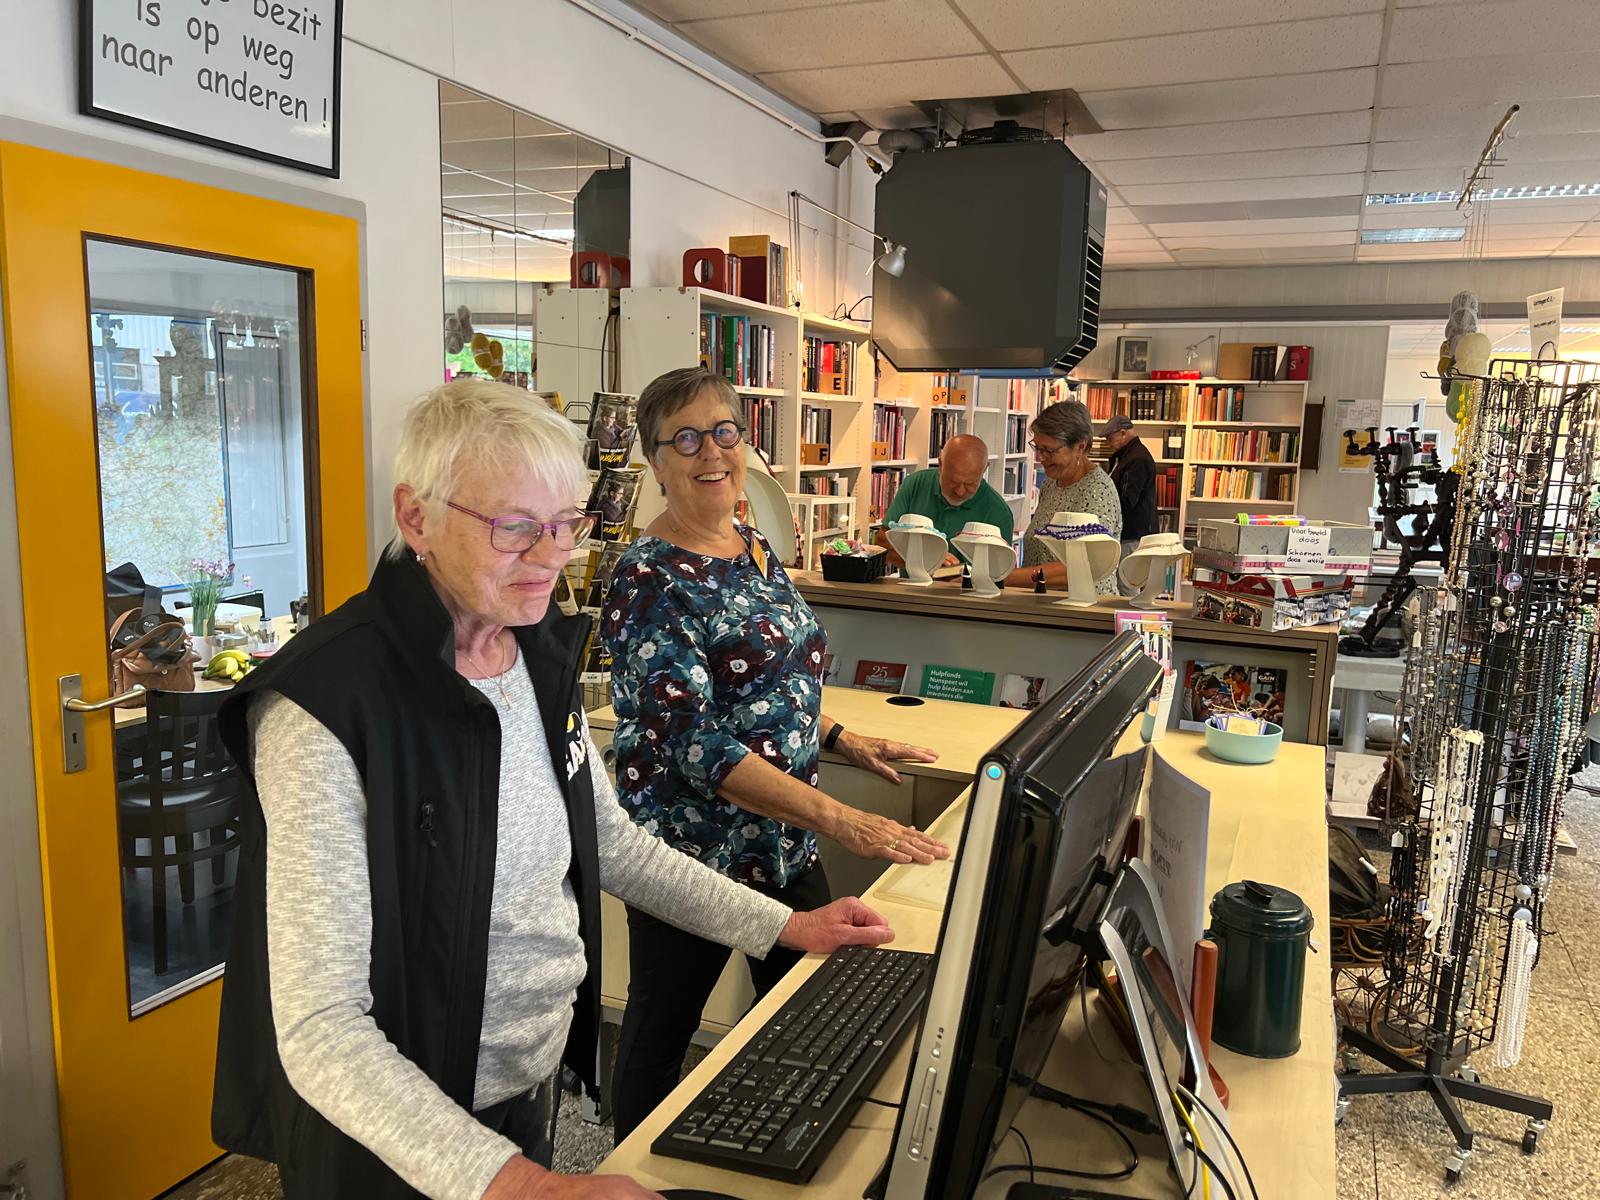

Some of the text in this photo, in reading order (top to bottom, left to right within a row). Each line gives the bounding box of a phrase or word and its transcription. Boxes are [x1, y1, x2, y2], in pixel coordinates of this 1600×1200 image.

[186, 17, 220, 54] op
[242, 34, 294, 80] weg
[102, 33, 174, 77] naar
[197, 70, 308, 123] anderen
[833, 377, 842, 390] E
[819, 447, 828, 462] F
[872, 665, 888, 679] 25
[930, 669, 961, 679] Hulpfonds
[927, 683, 941, 691] hulp
[929, 676, 958, 686] Nunspeet
